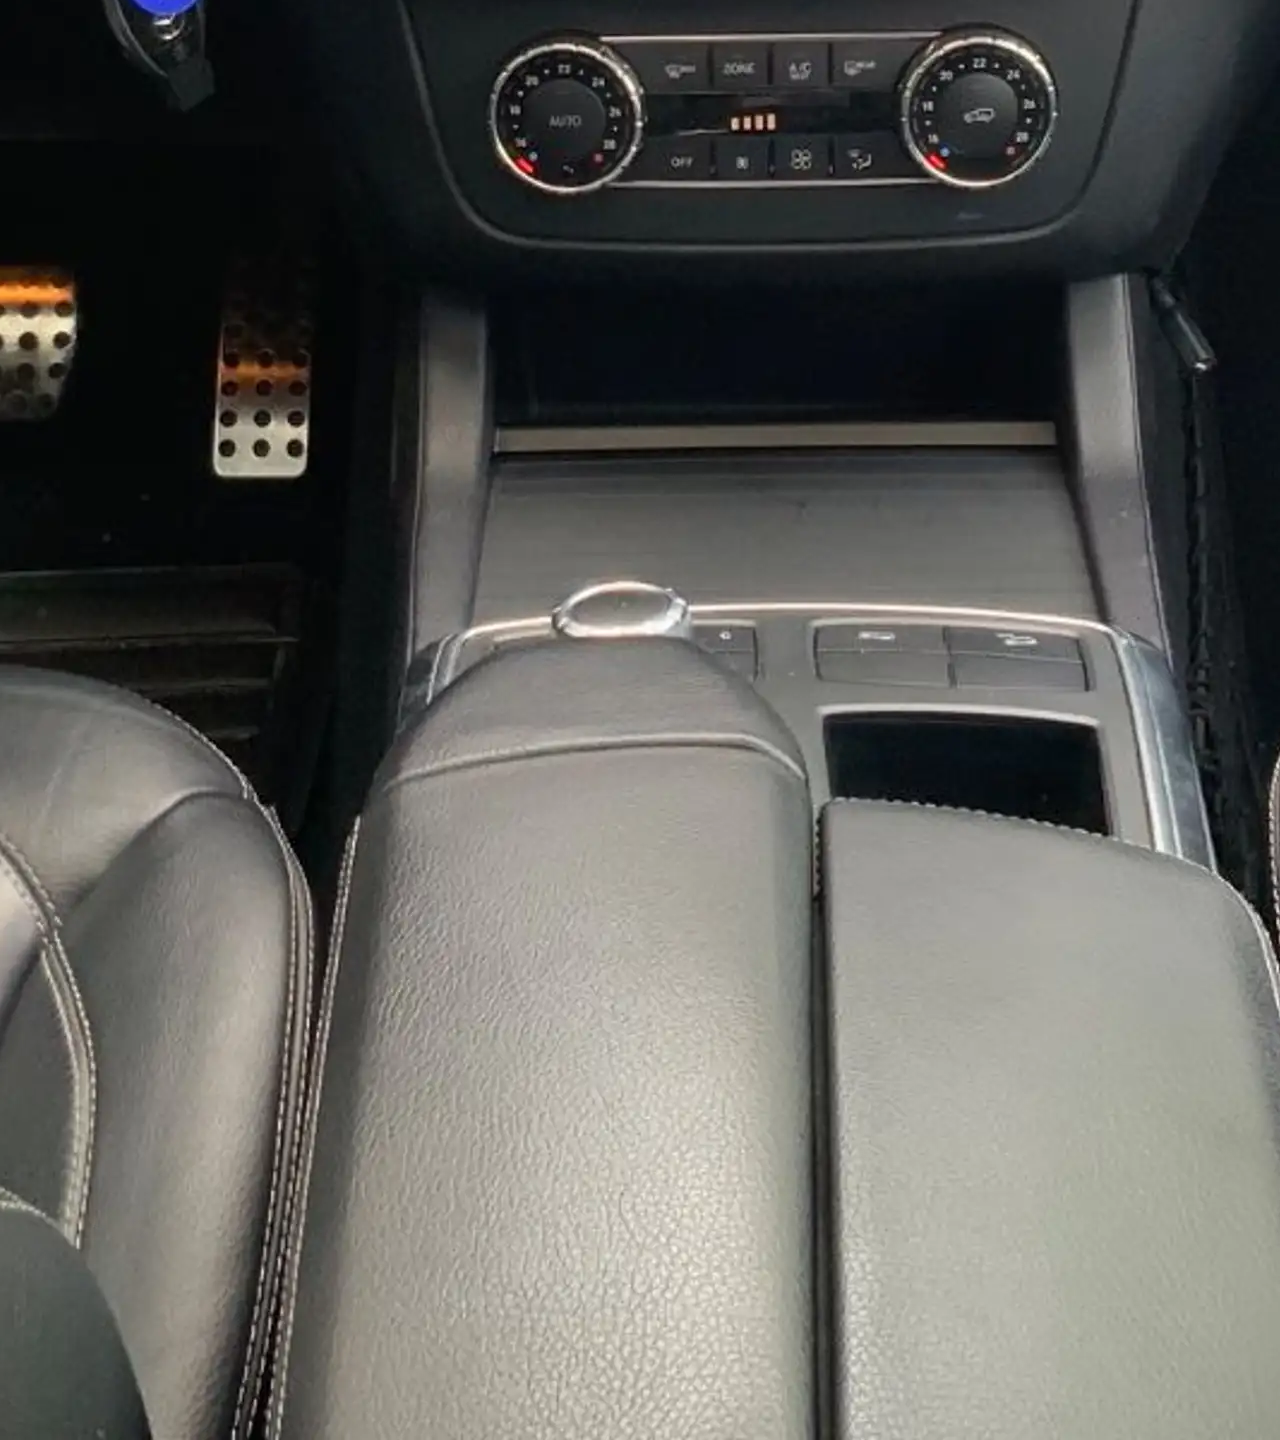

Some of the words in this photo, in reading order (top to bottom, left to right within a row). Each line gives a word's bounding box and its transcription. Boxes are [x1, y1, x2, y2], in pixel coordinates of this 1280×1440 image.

[972, 58, 987, 68] 22
[1006, 70, 1020, 80] 24
[549, 115, 582, 128] AUTO
[669, 156, 693, 168] OFF
